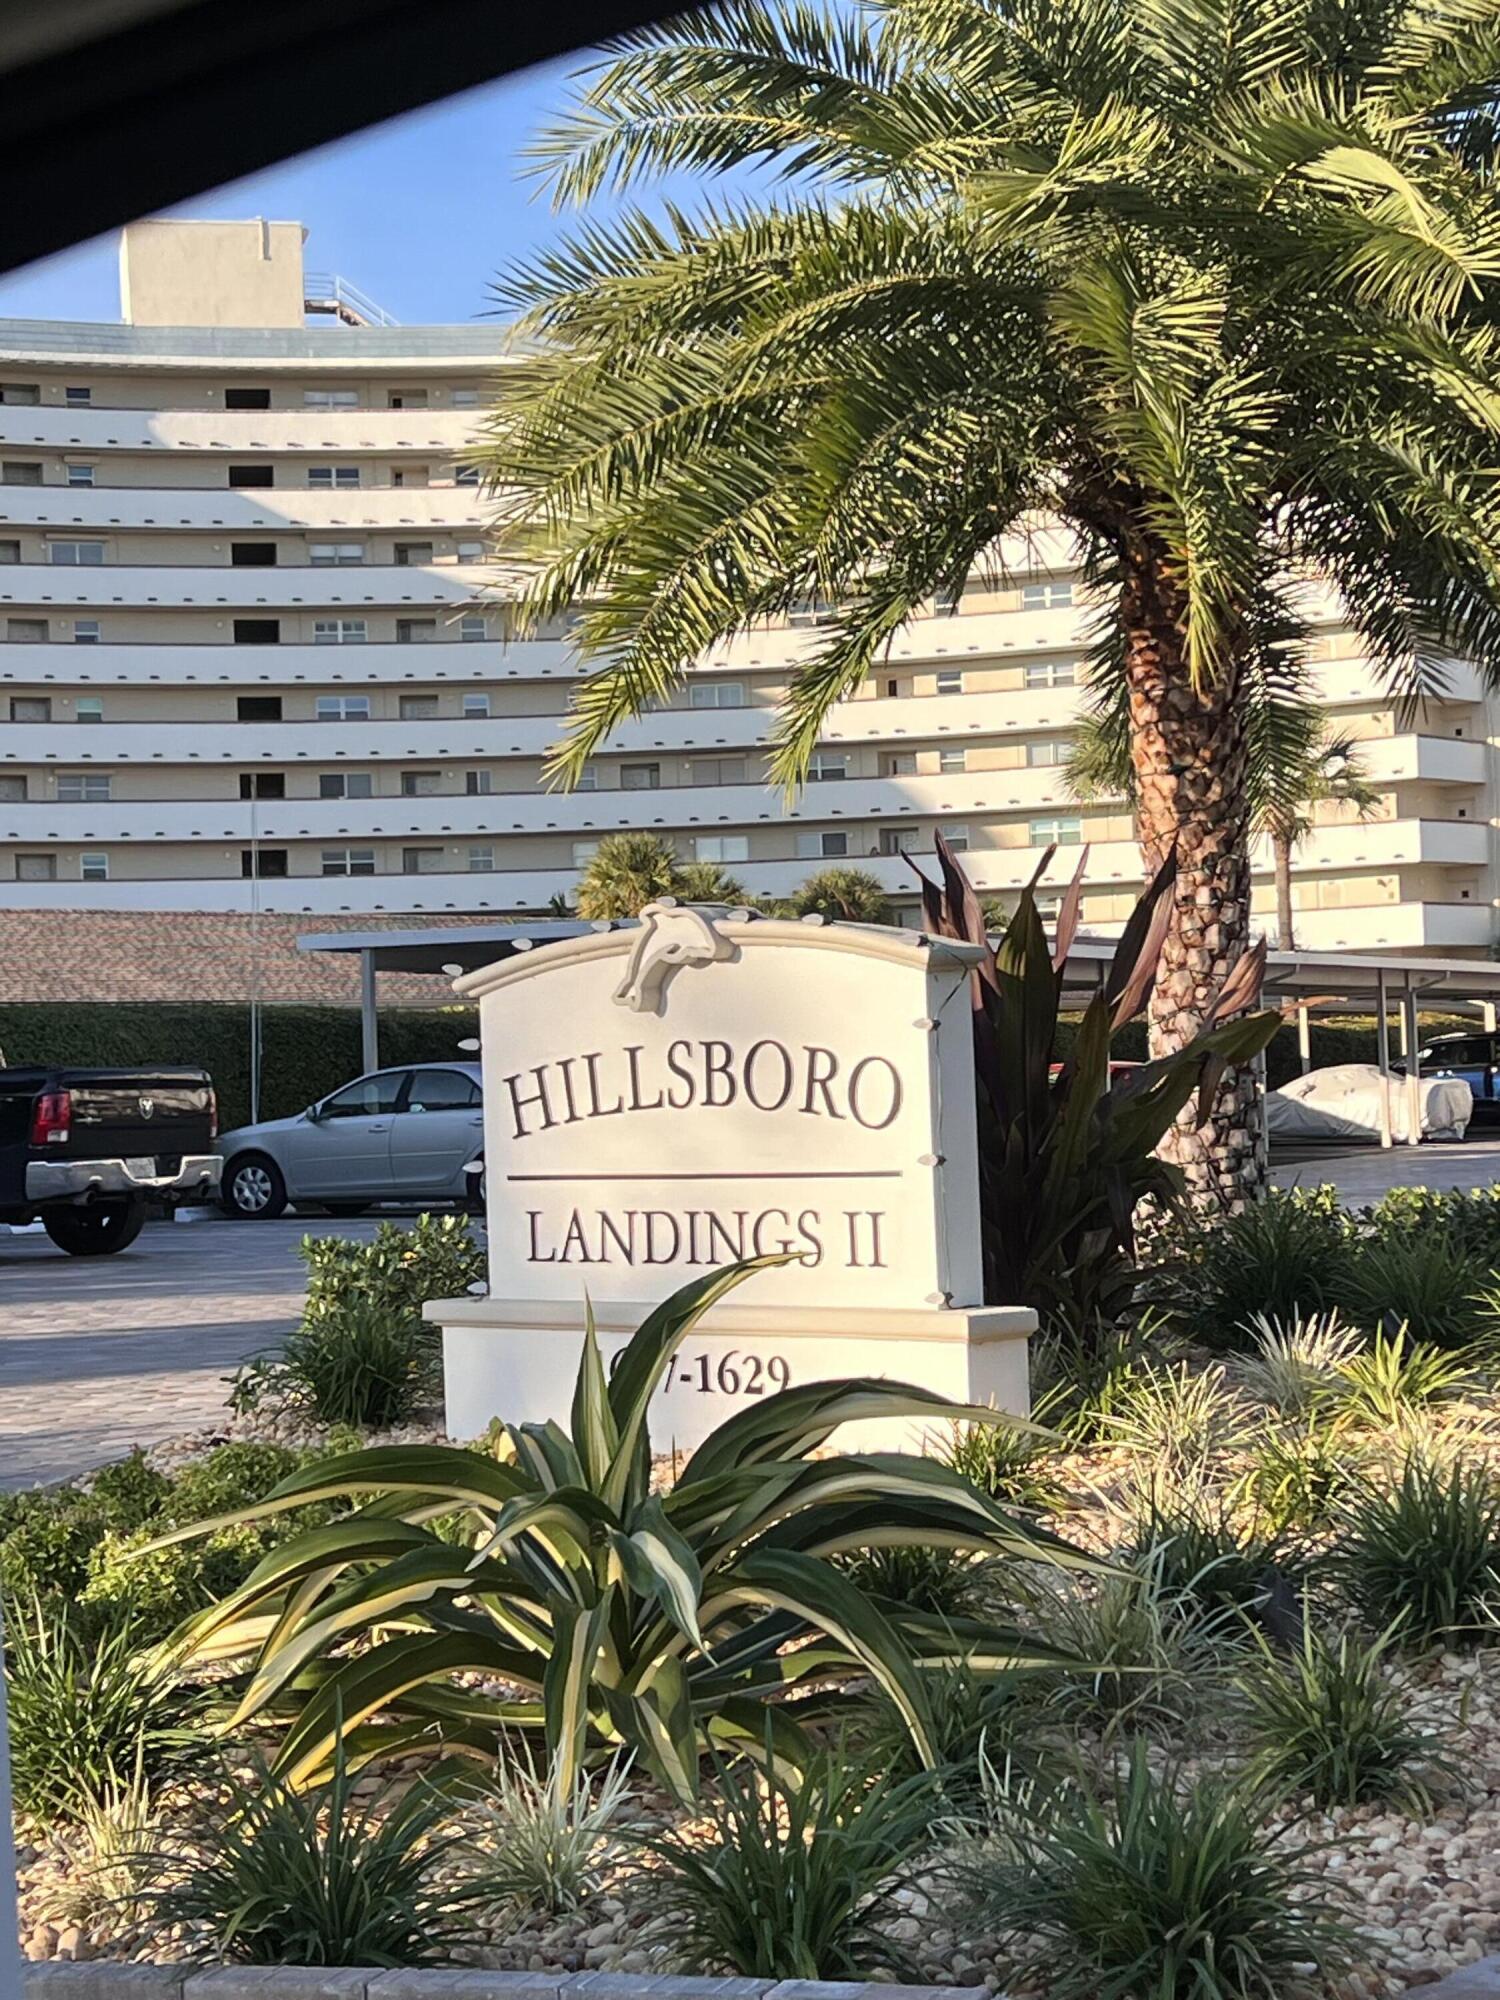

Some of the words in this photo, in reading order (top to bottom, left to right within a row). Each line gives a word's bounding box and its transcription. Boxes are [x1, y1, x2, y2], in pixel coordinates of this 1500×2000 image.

[502, 1039, 903, 1139] HILLSBORO
[526, 1207, 823, 1268] LANDINGS
[842, 1211, 889, 1268] II
